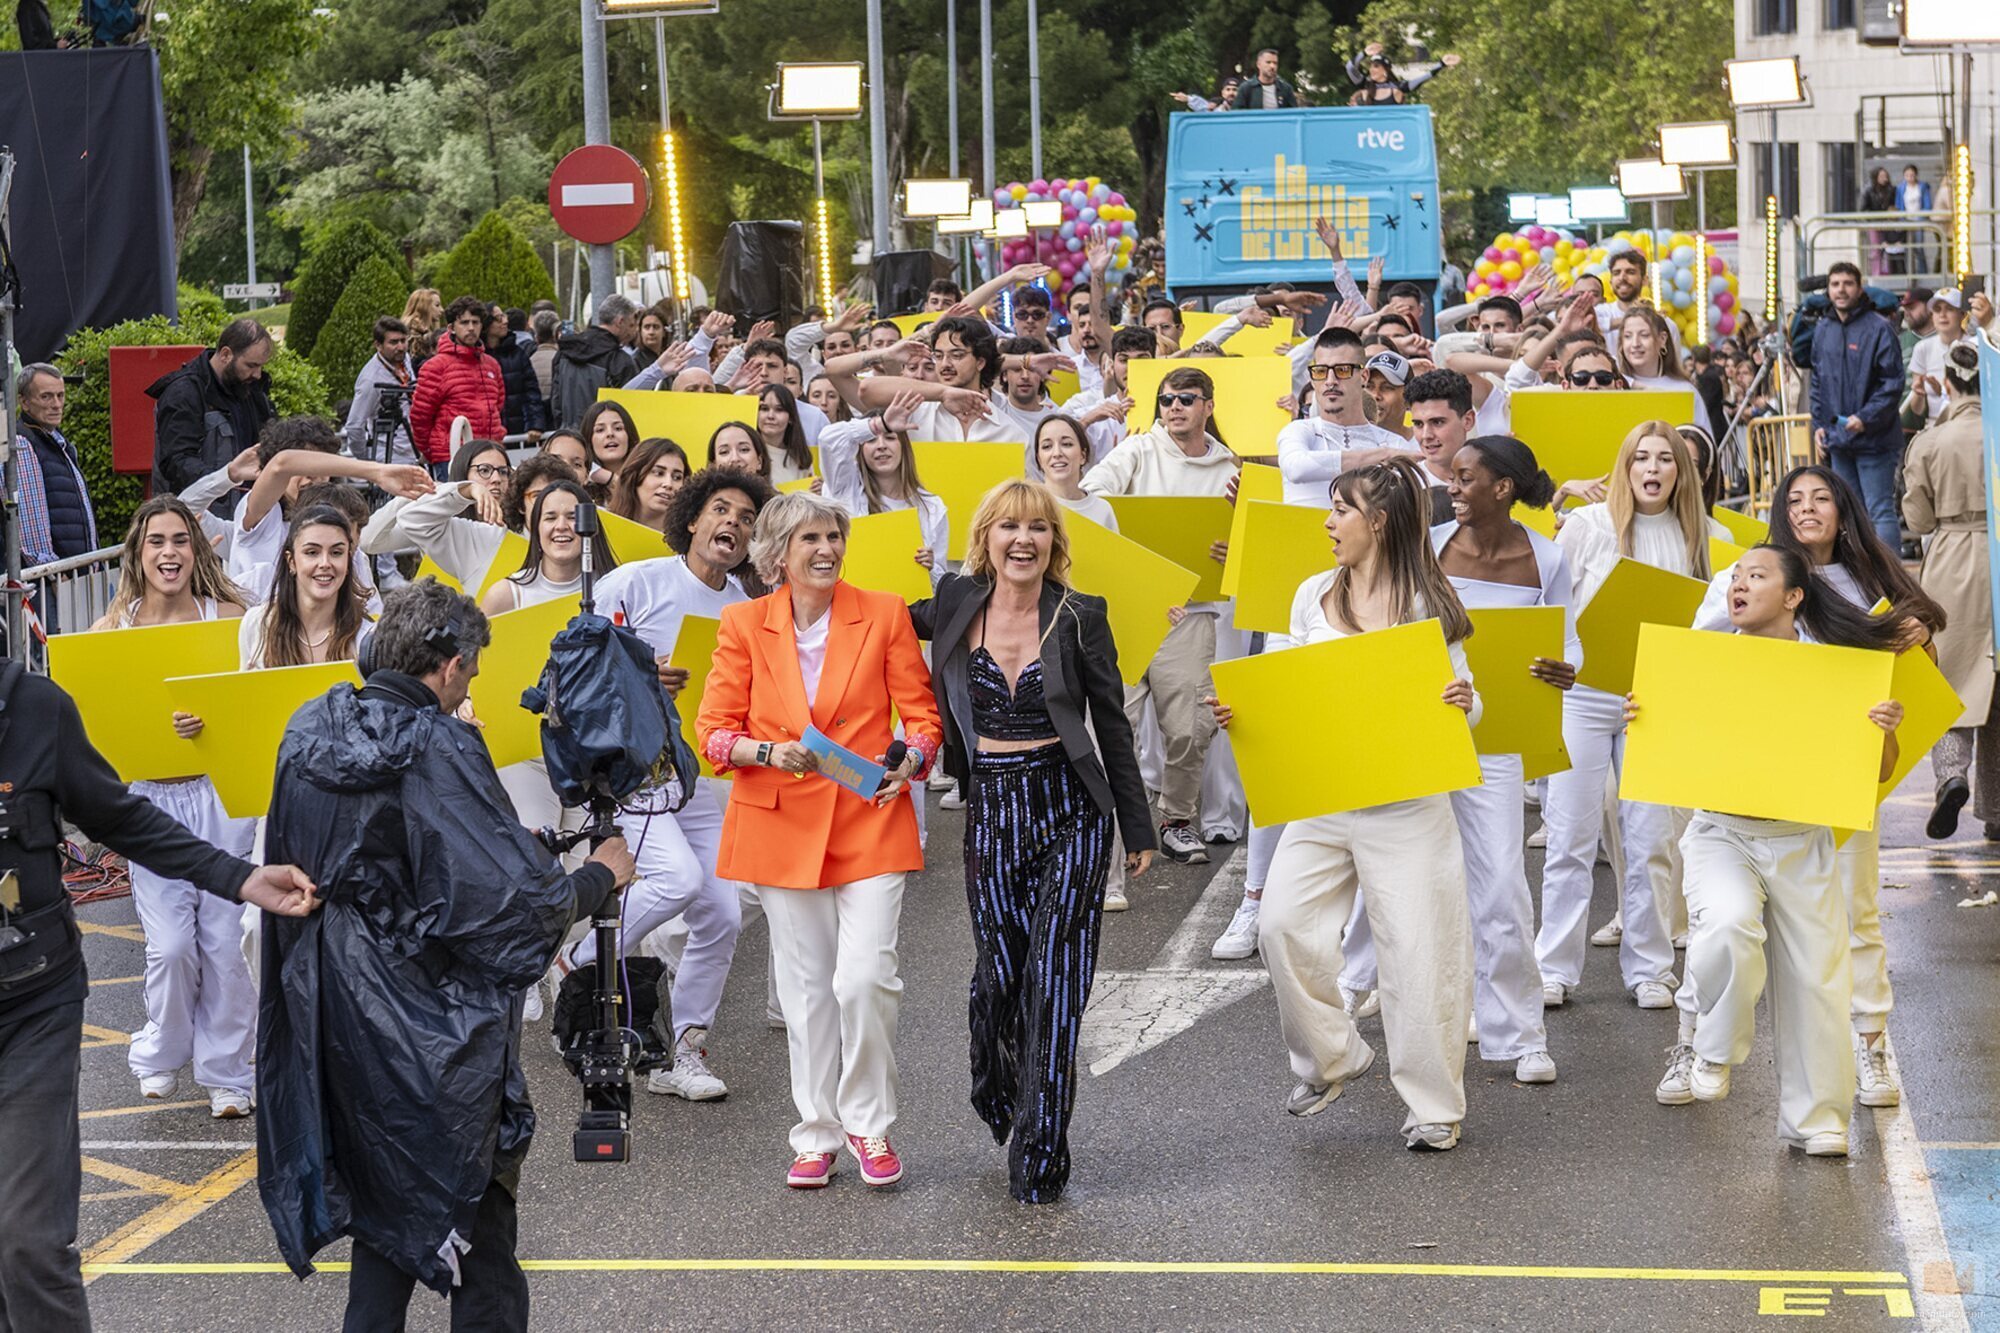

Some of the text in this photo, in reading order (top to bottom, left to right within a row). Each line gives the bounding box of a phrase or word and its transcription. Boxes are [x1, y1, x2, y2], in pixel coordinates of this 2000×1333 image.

[1357, 128, 1404, 151] rtve
[1275, 154, 1307, 198] la
[1304, 231, 1369, 259] TLE
